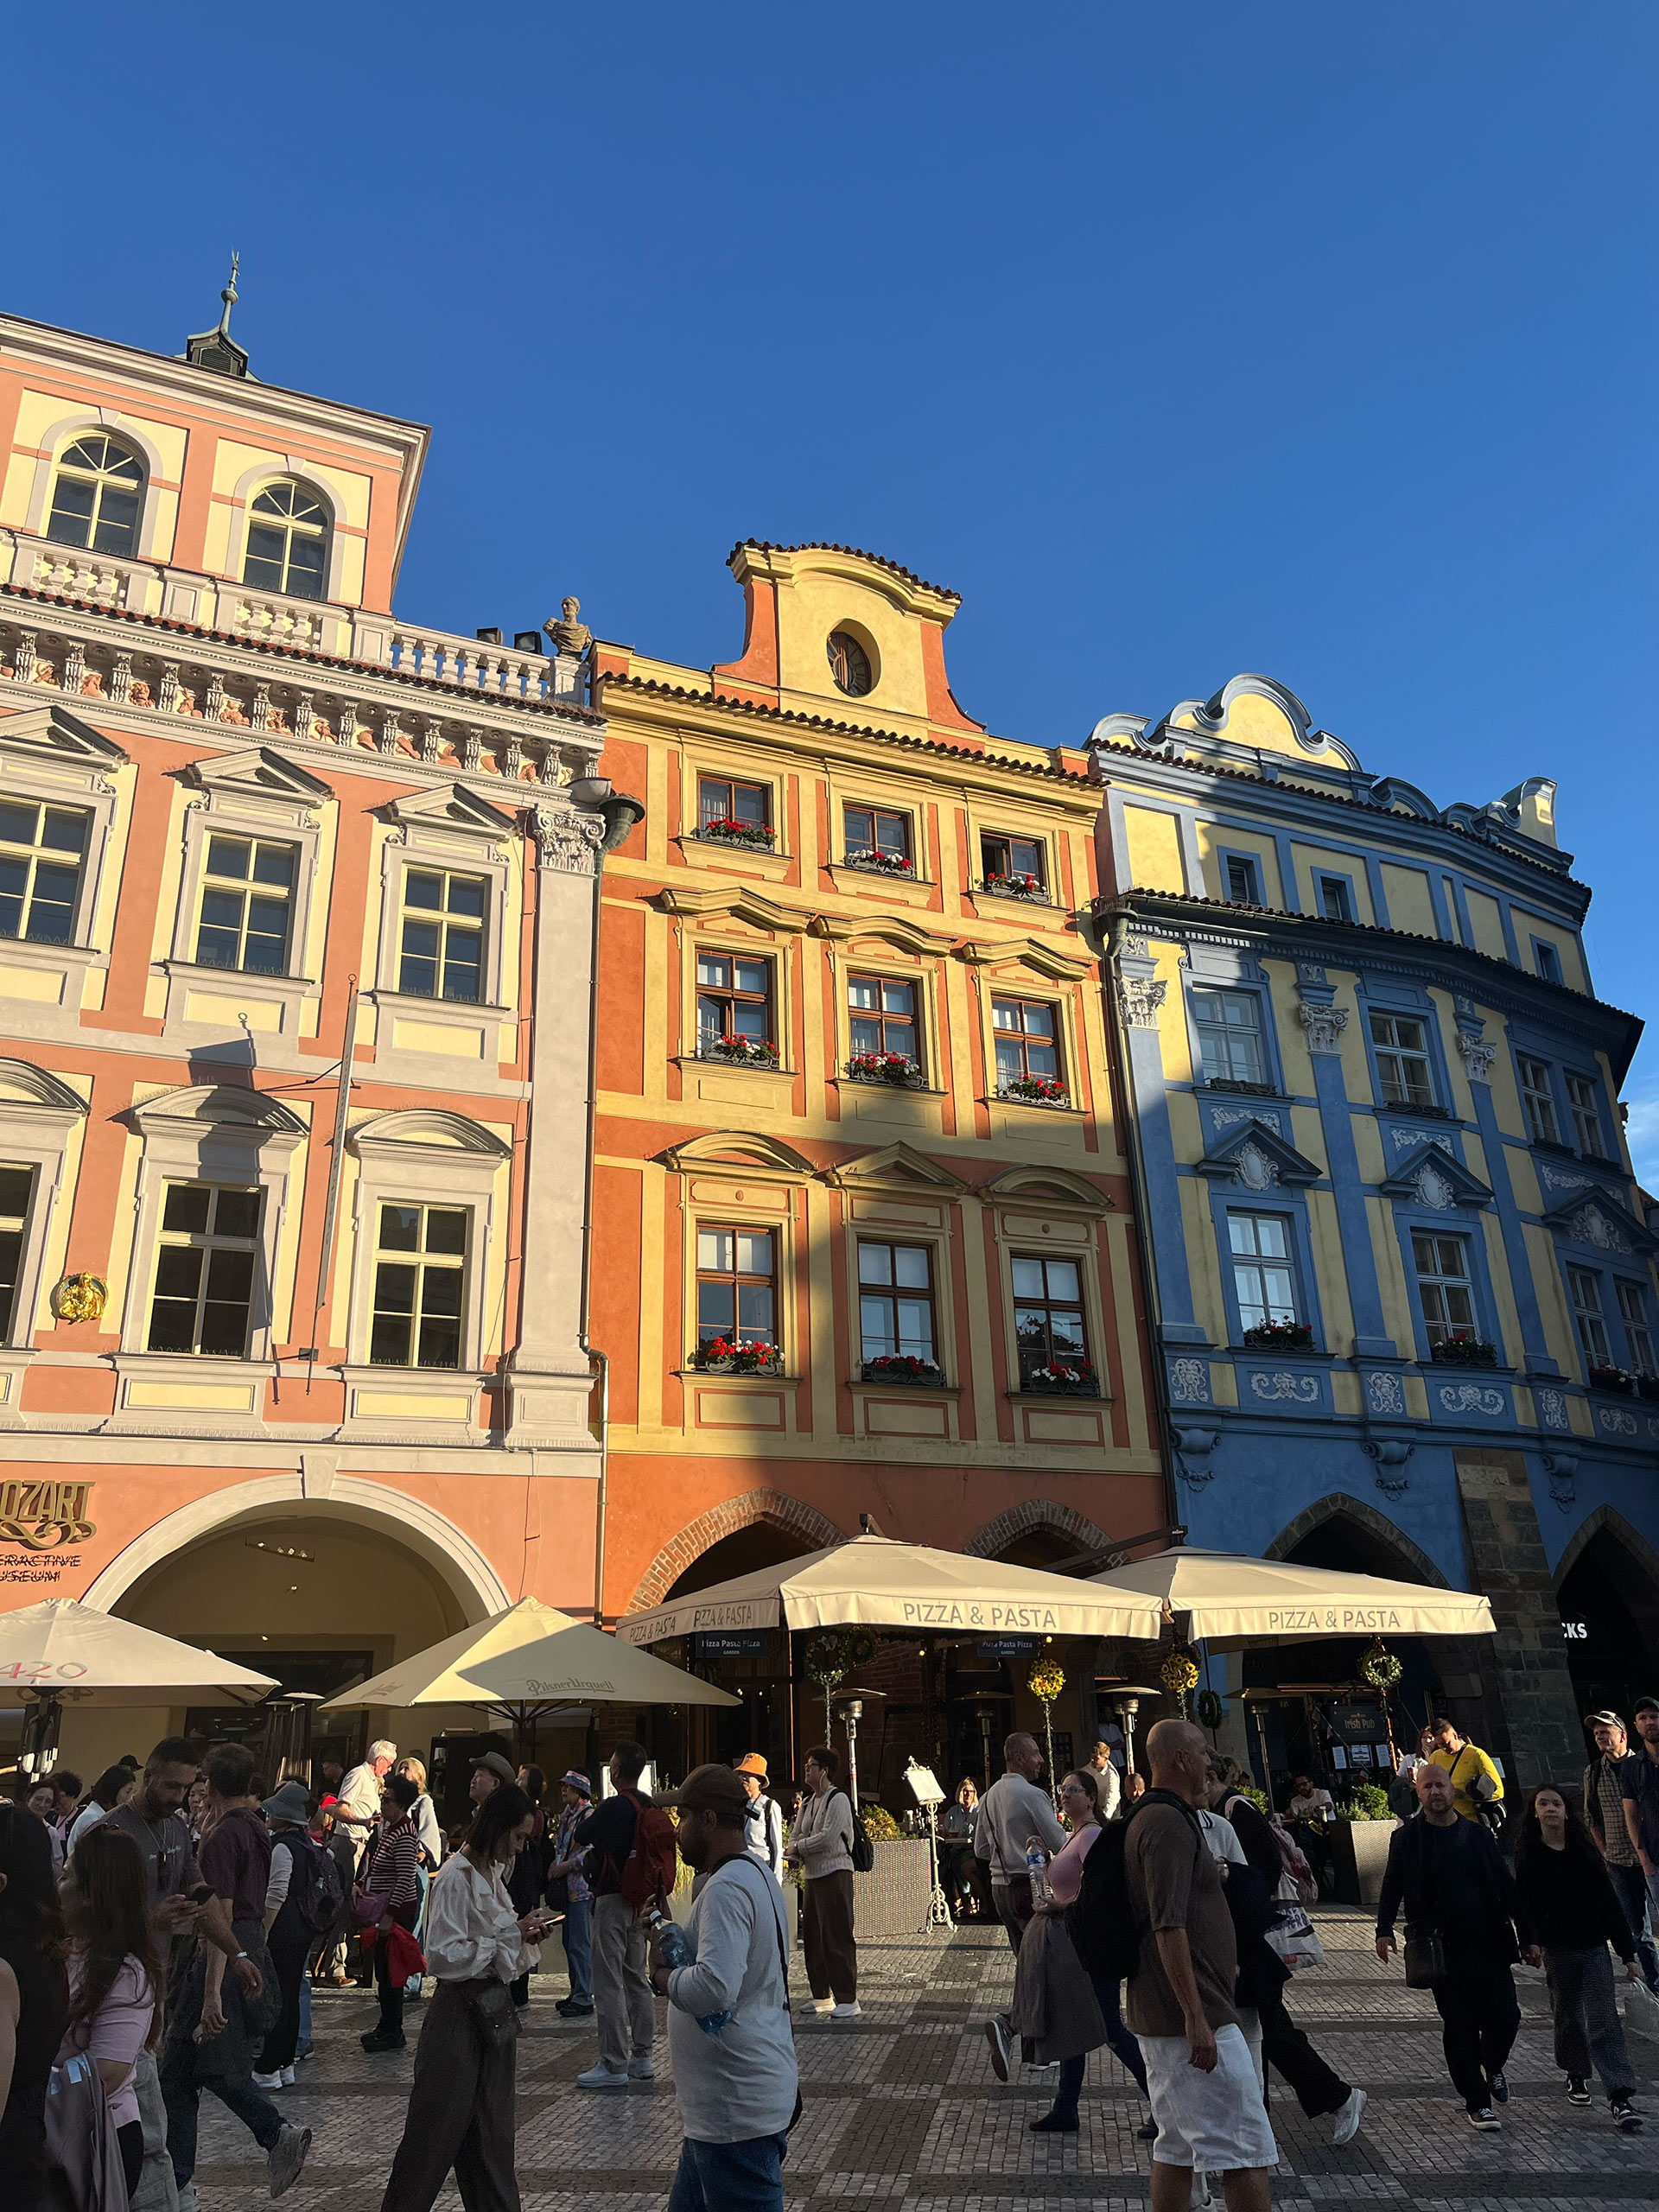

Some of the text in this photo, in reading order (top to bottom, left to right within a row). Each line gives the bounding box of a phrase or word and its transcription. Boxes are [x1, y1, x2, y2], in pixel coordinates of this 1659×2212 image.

[694, 1605, 753, 1628] PIZZA & PASTA
[903, 1603, 1057, 1628] PIZZA & PASTA
[1268, 1611, 1401, 1630] PIZZA & PASTA
[0, 1662, 88, 1679] 420
